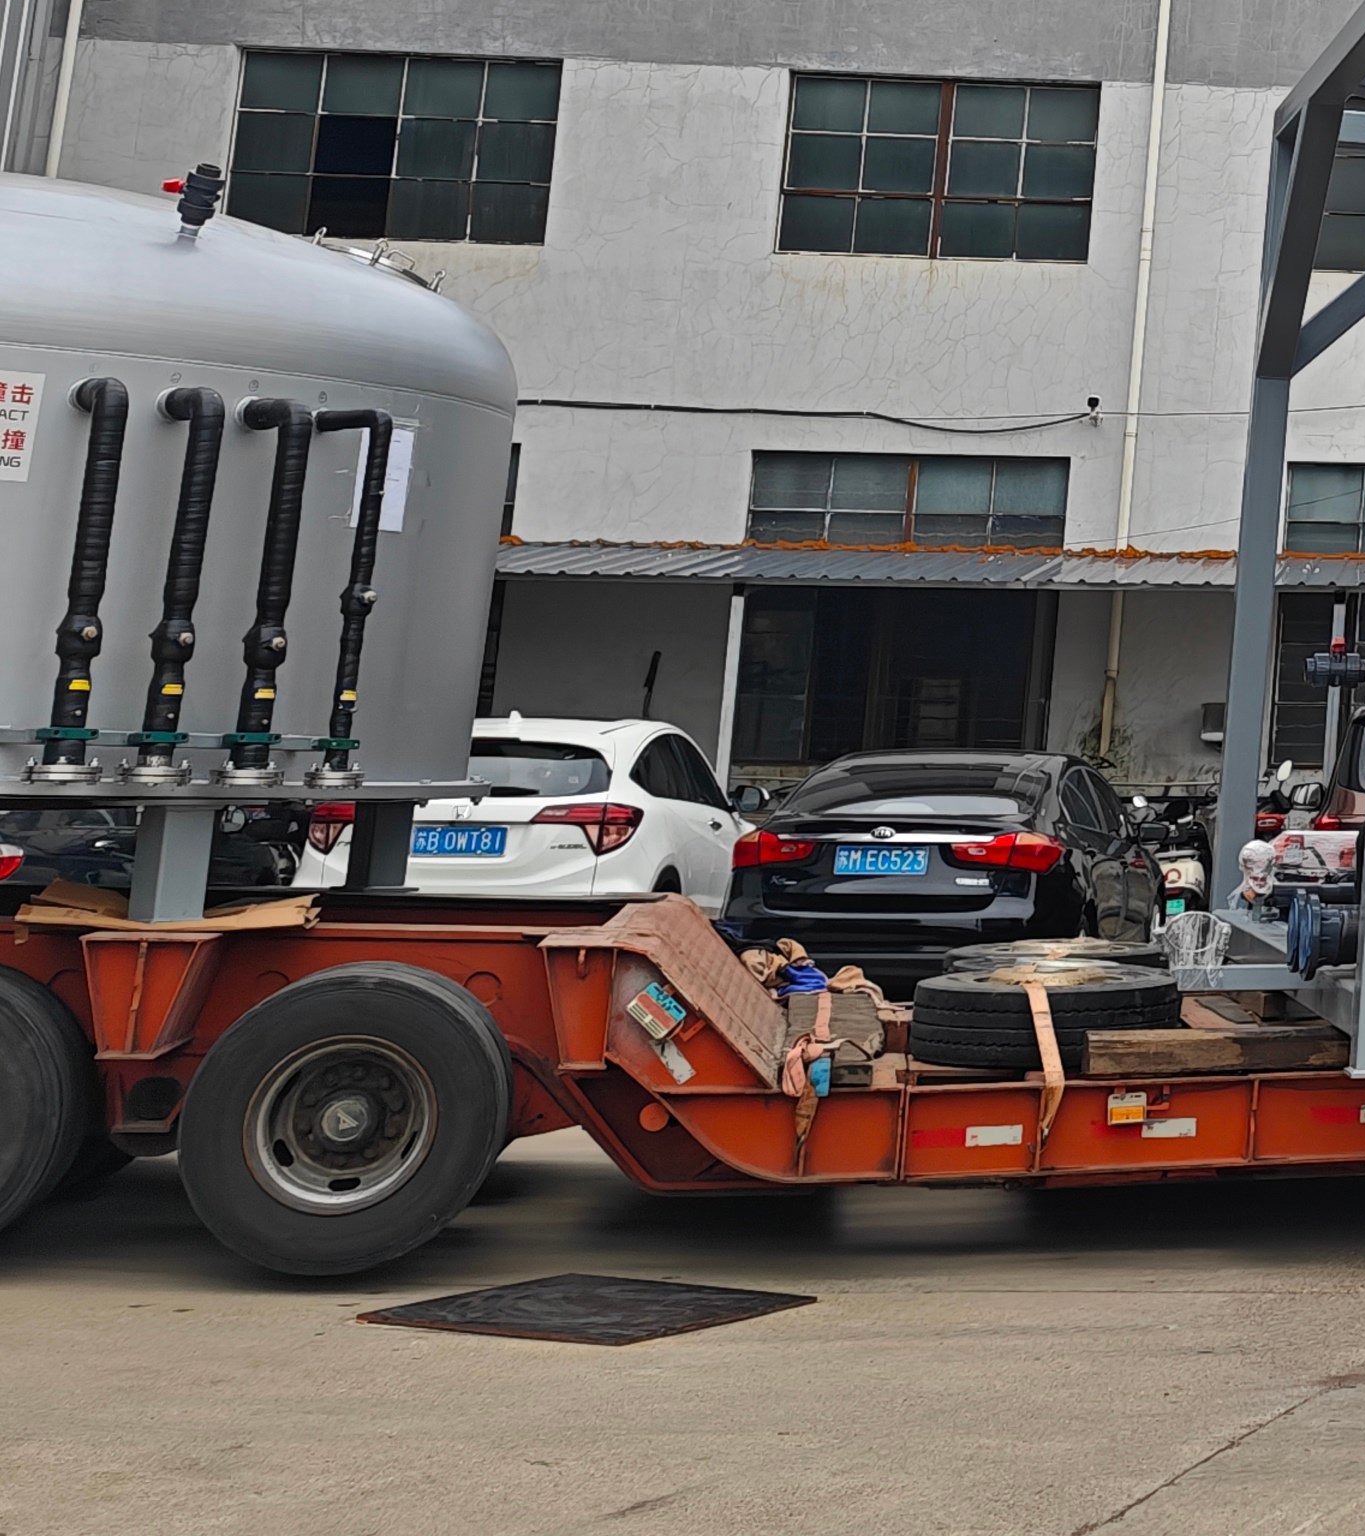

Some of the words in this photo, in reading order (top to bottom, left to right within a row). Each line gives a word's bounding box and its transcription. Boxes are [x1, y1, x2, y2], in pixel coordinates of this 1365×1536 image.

[0, 409, 29, 421] ACT
[1, 429, 26, 451] 撞
[0, 456, 21, 467] NG
